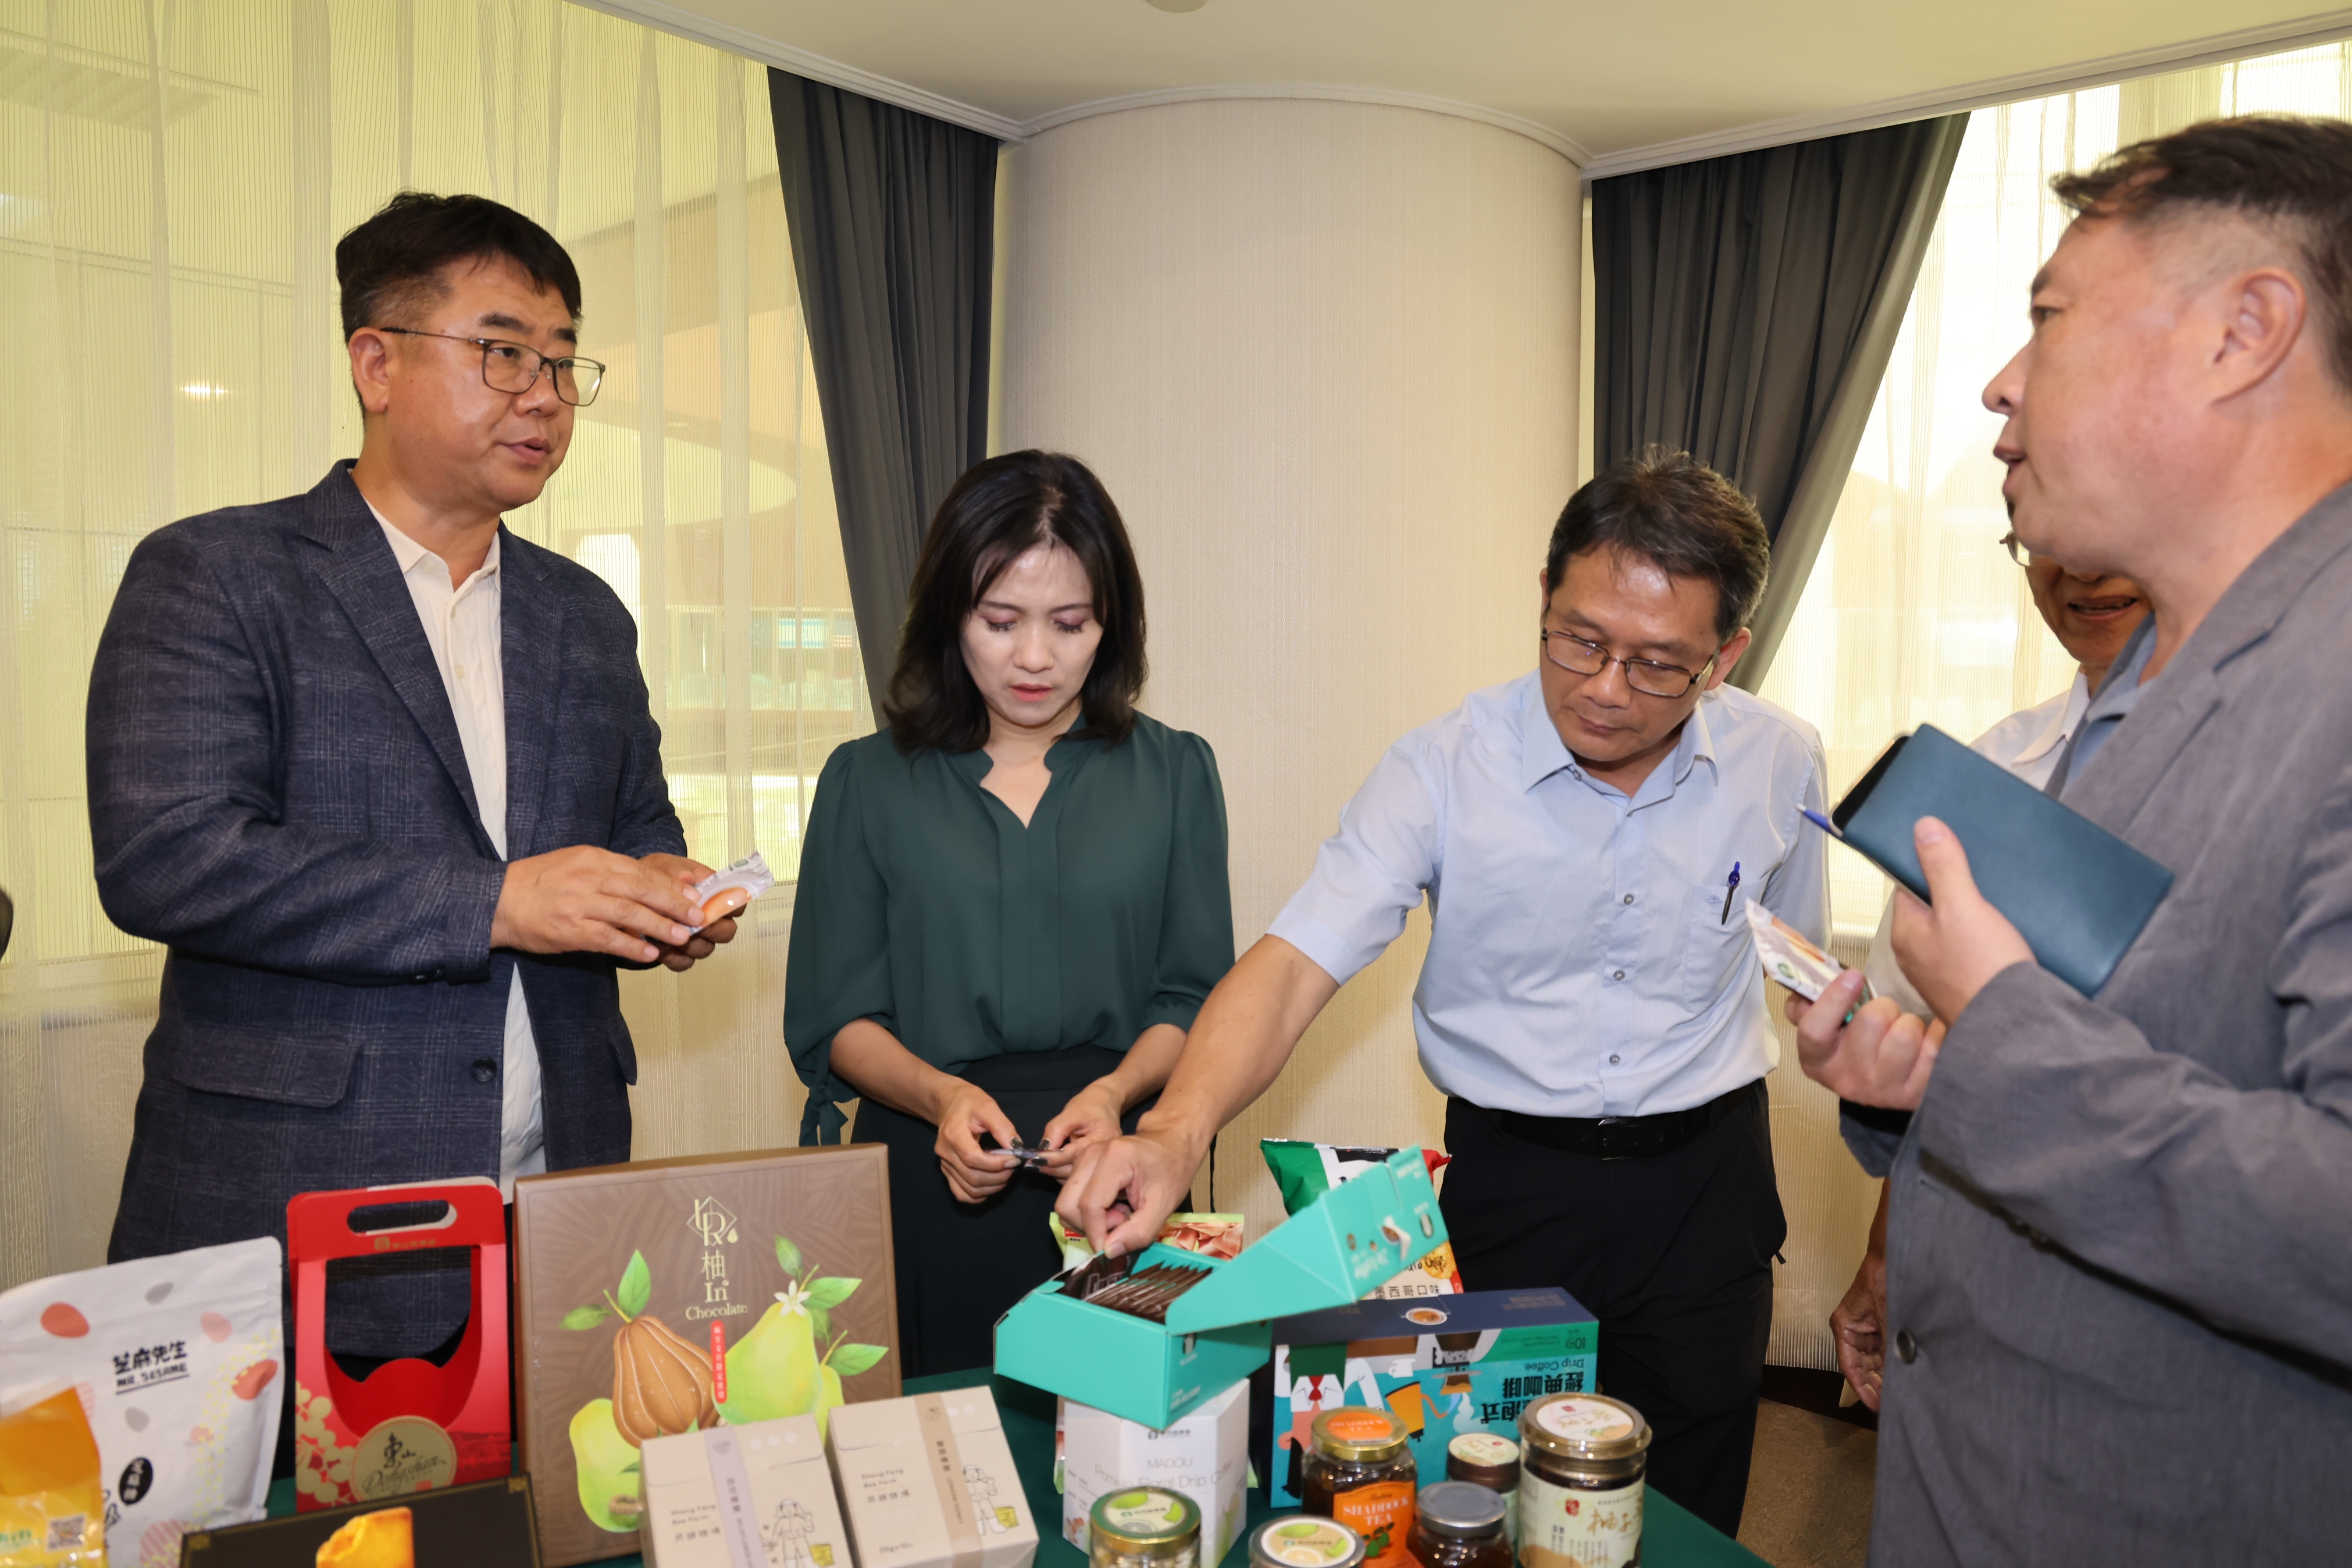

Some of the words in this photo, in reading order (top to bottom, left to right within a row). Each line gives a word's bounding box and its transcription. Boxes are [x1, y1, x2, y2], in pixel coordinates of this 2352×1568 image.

[701, 1249, 725, 1280] 柚
[704, 1282, 728, 1303] In
[1375, 1285, 1440, 1299] 墨西哥口味
[686, 1303, 747, 1320] Chocolate
[1525, 1360, 1559, 1370] Coffee
[1562, 1359, 1584, 1368] Drip
[1503, 1371, 1584, 1399] 經典咖啡
[1147, 1458, 1192, 1469] MADOU
[1179, 1476, 1207, 1489] Drip
[1343, 1496, 1409, 1516] SHADDOCK
[1366, 1513, 1392, 1526] TEA
